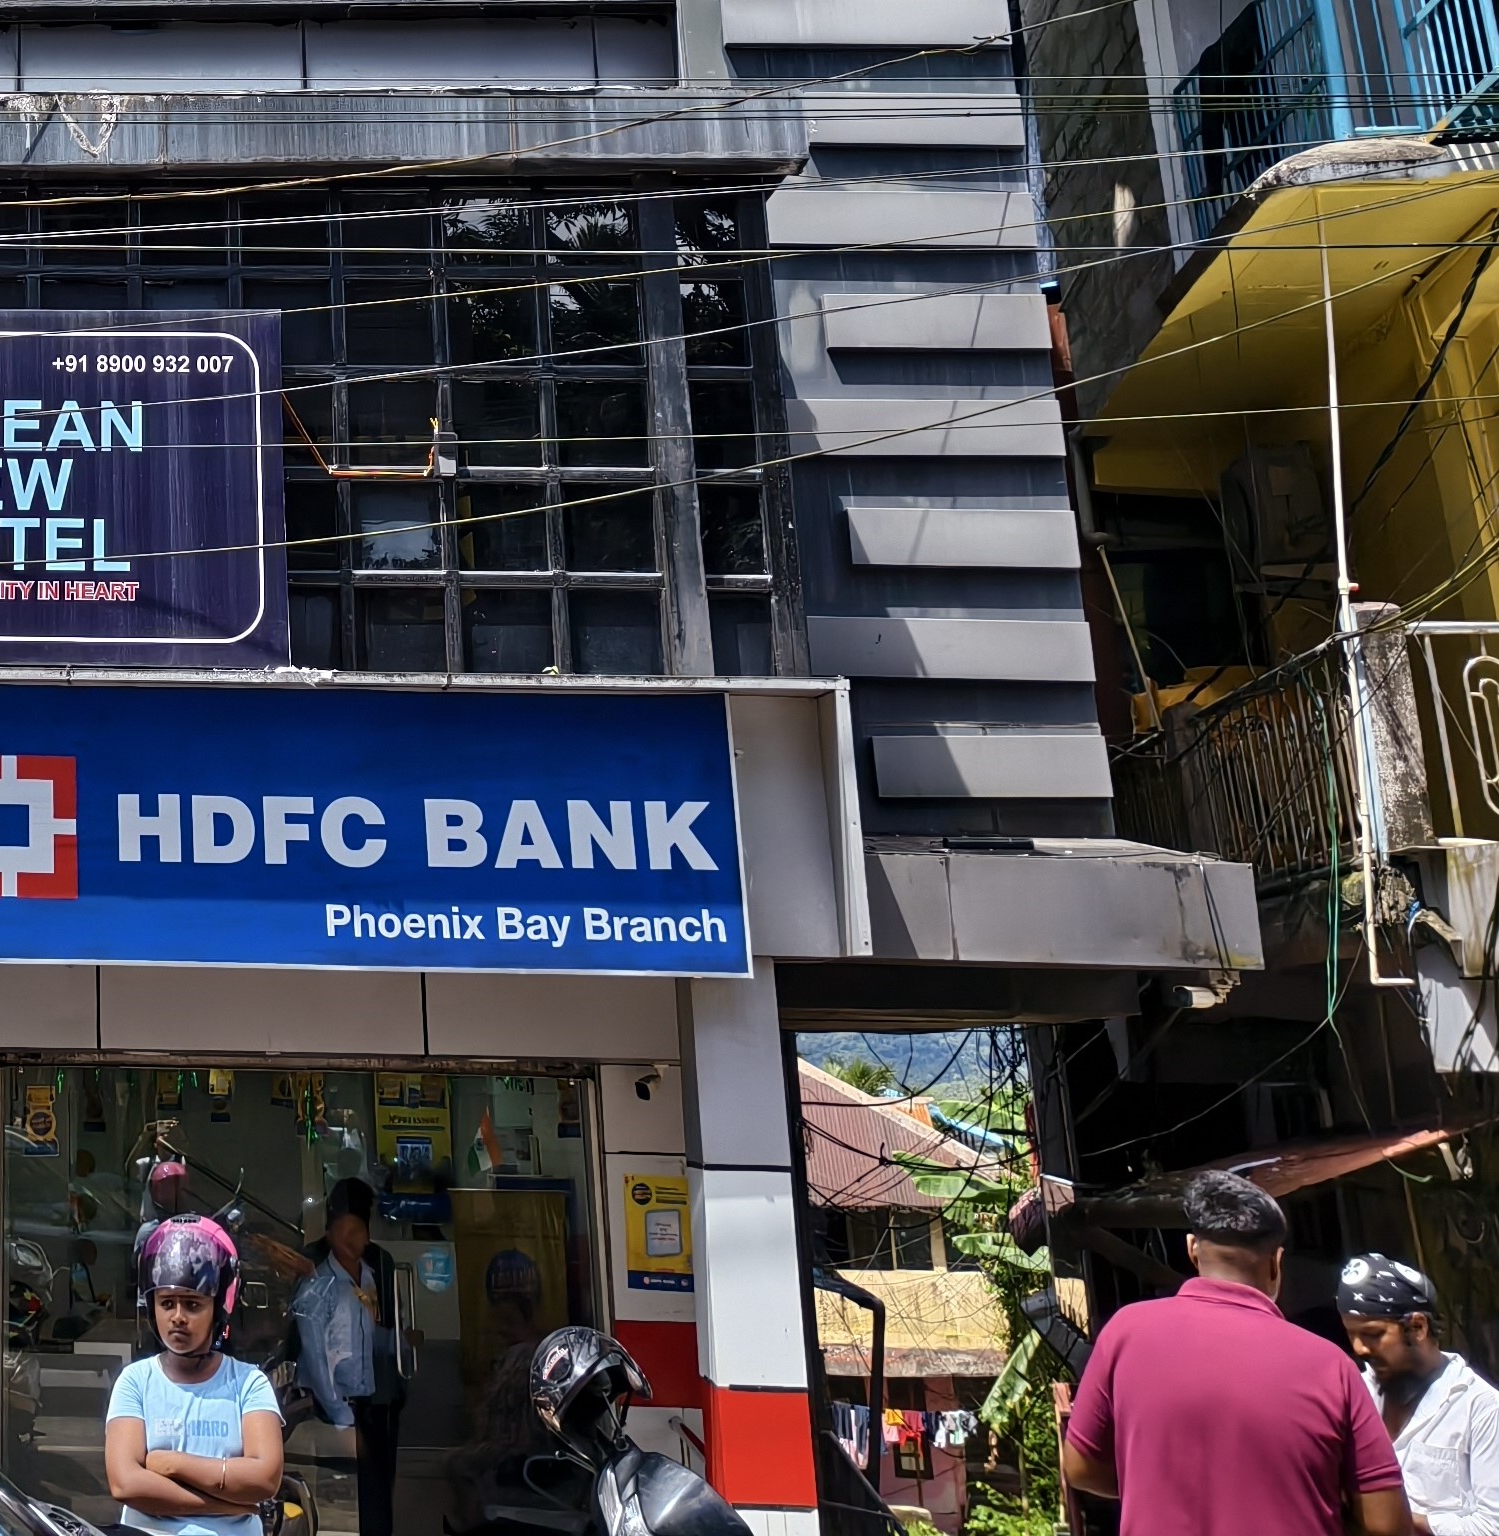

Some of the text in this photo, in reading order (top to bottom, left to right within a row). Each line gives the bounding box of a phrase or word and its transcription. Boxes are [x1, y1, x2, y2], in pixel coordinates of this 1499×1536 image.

[51, 354, 234, 374] +91 8900 932 007
[36, 580, 60, 601] IN
[64, 580, 140, 602] HEART
[117, 793, 720, 871] HDFC BANK
[325, 904, 728, 948] Phoenix Bay Branch
